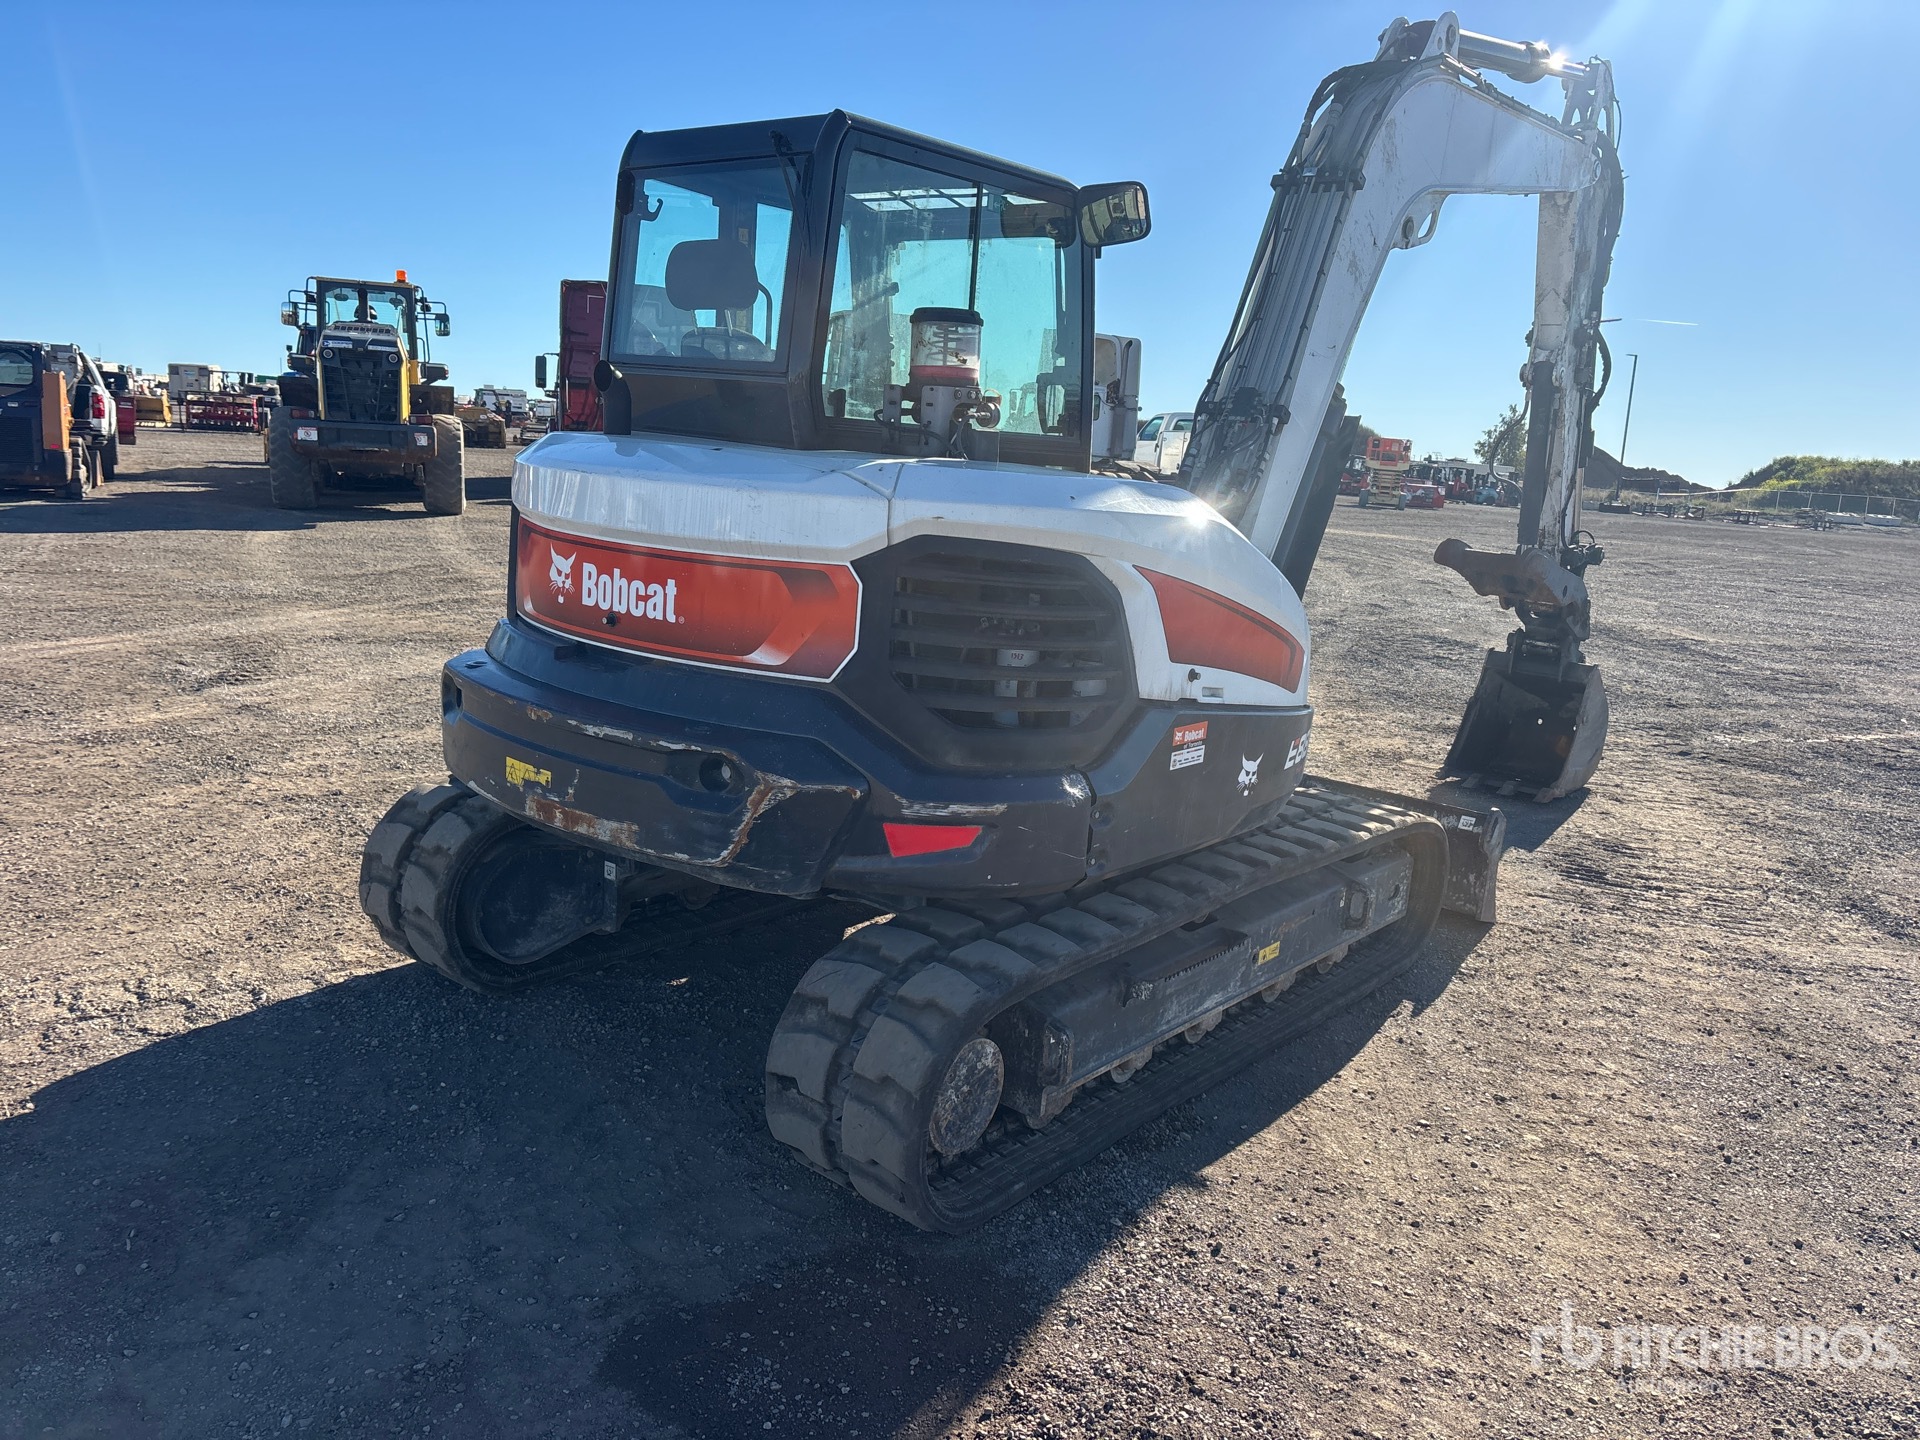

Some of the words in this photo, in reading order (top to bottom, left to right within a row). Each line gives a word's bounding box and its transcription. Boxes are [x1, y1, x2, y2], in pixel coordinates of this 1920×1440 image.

[581, 562, 678, 623] Bobcat
[1184, 727, 1205, 742] Bobcat
[1283, 729, 1310, 771] E8
